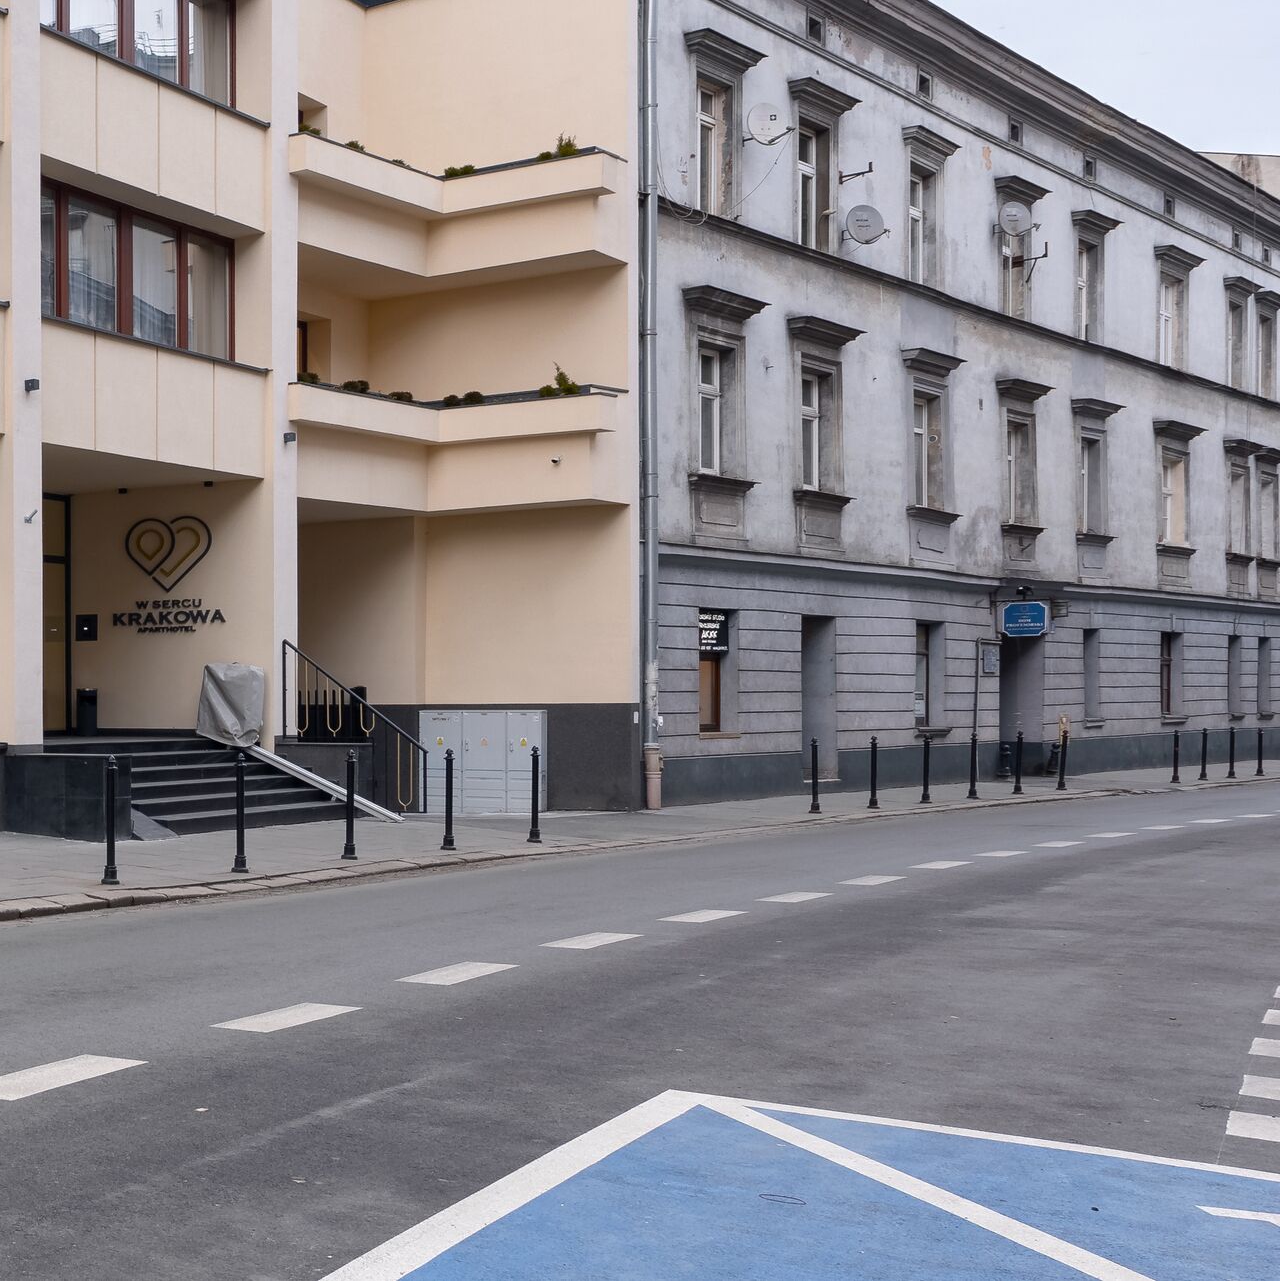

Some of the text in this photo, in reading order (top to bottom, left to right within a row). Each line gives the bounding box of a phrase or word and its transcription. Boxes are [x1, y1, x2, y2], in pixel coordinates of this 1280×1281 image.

[135, 598, 202, 610] W SERCU
[112, 609, 226, 627] KRAKOWA
[137, 625, 196, 633] APARTHOTEL
